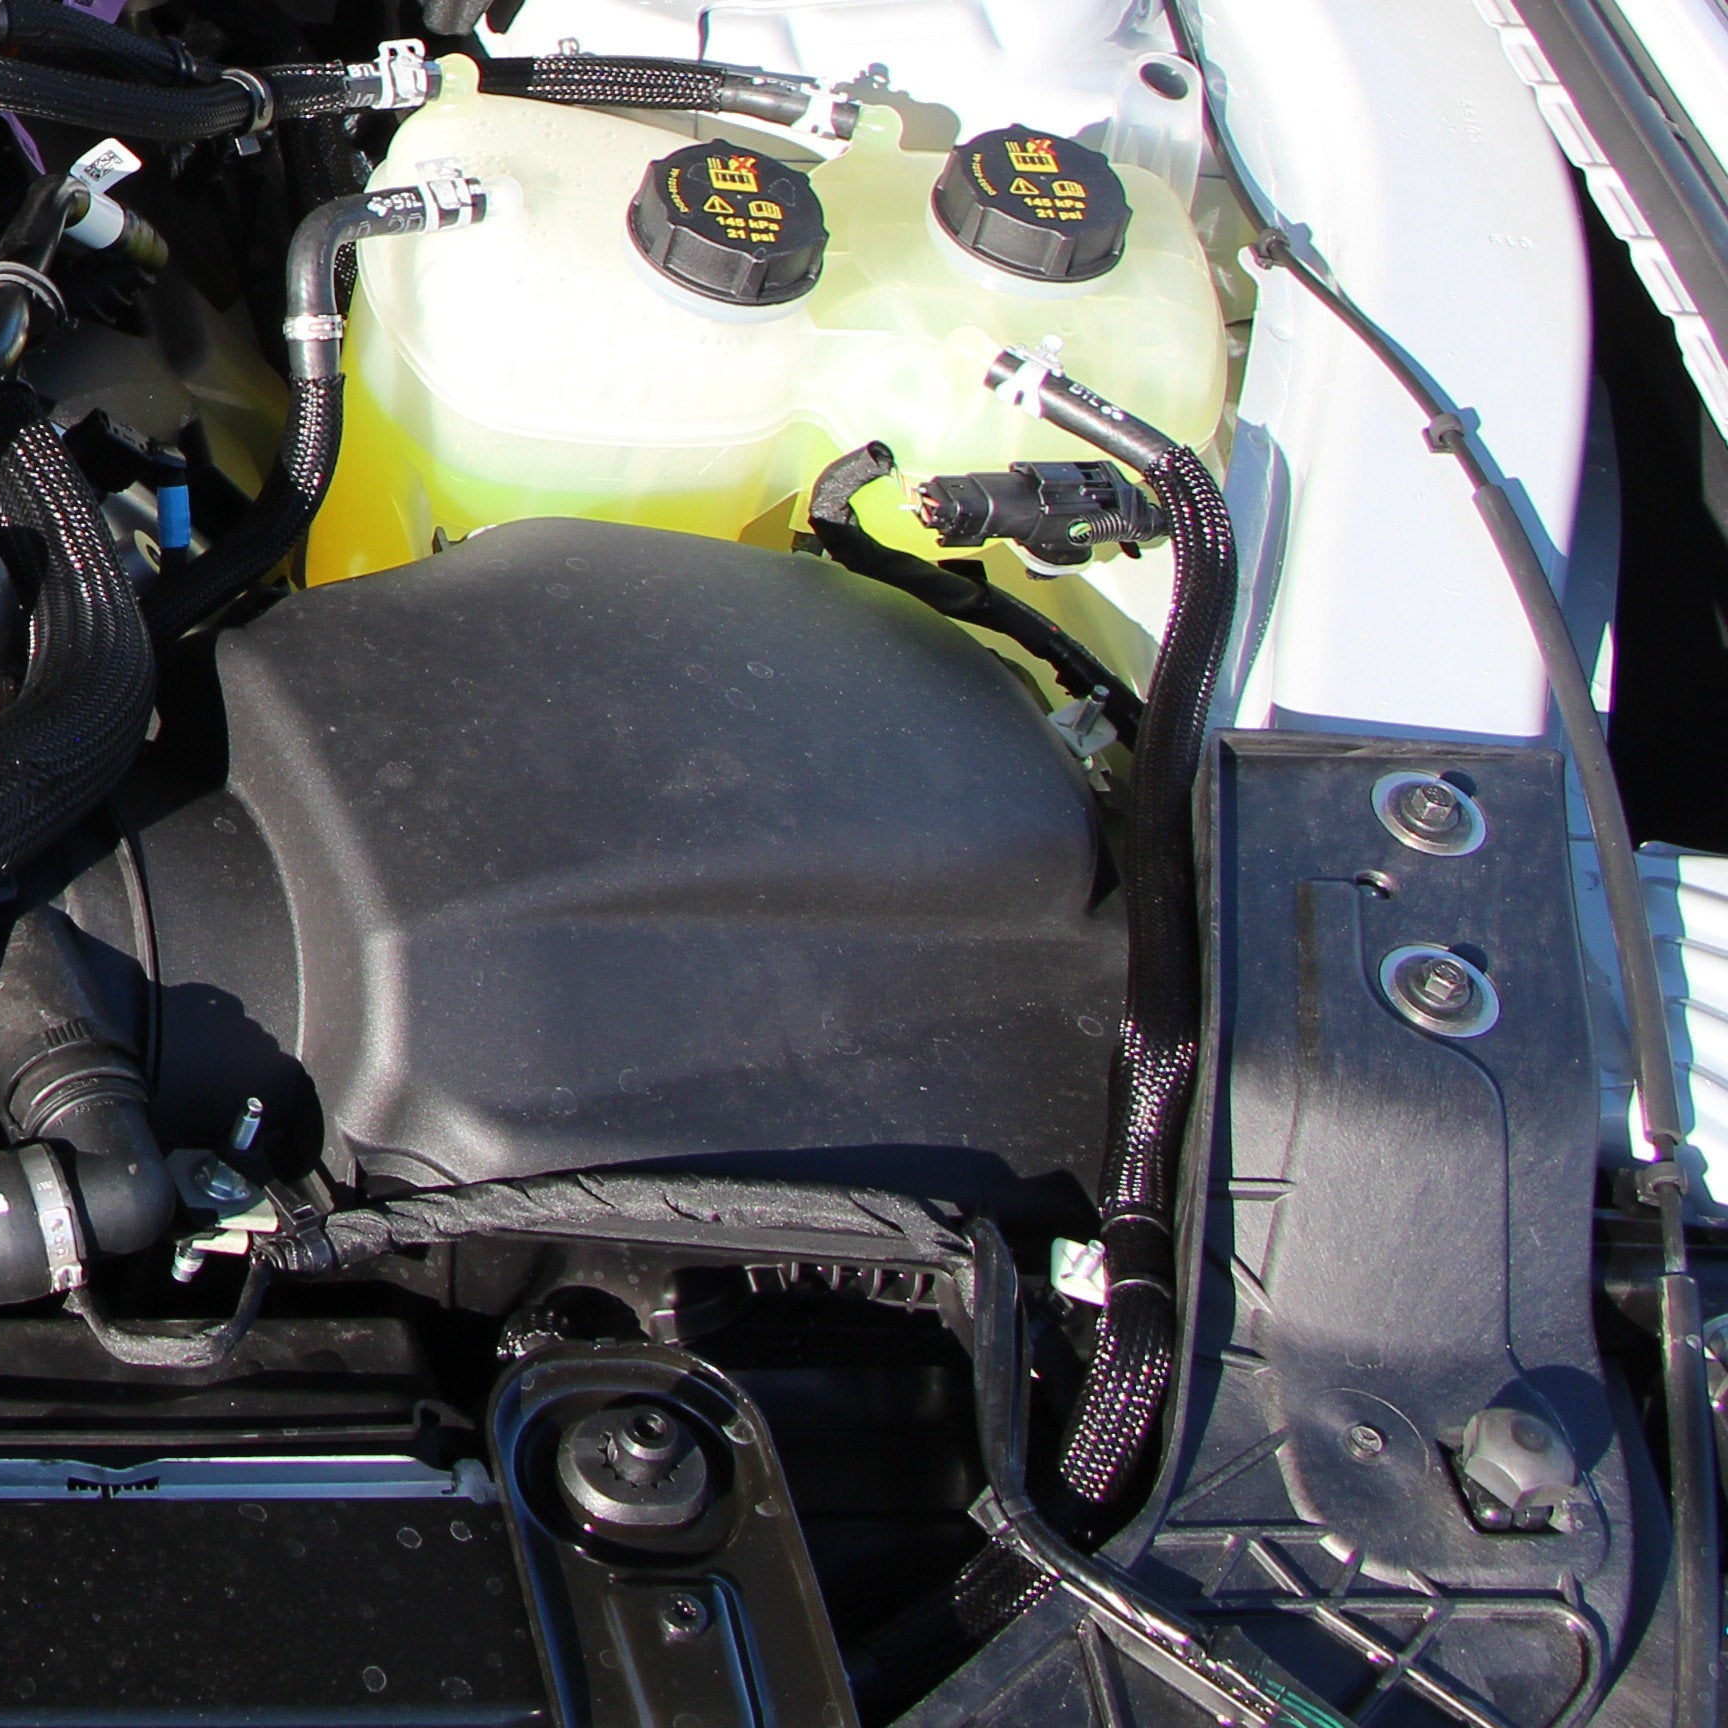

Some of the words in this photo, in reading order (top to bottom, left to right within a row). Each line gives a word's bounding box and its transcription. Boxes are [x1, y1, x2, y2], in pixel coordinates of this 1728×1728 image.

[1022, 196, 1052, 208] 145
[1054, 197, 1086, 210] kPa
[1034, 208, 1055, 219] 21
[1058, 210, 1083, 222] psi
[715, 215, 747, 228] 145
[748, 218, 781, 231] kPa
[725, 228, 746, 240] 21
[750, 231, 776, 244] psi
